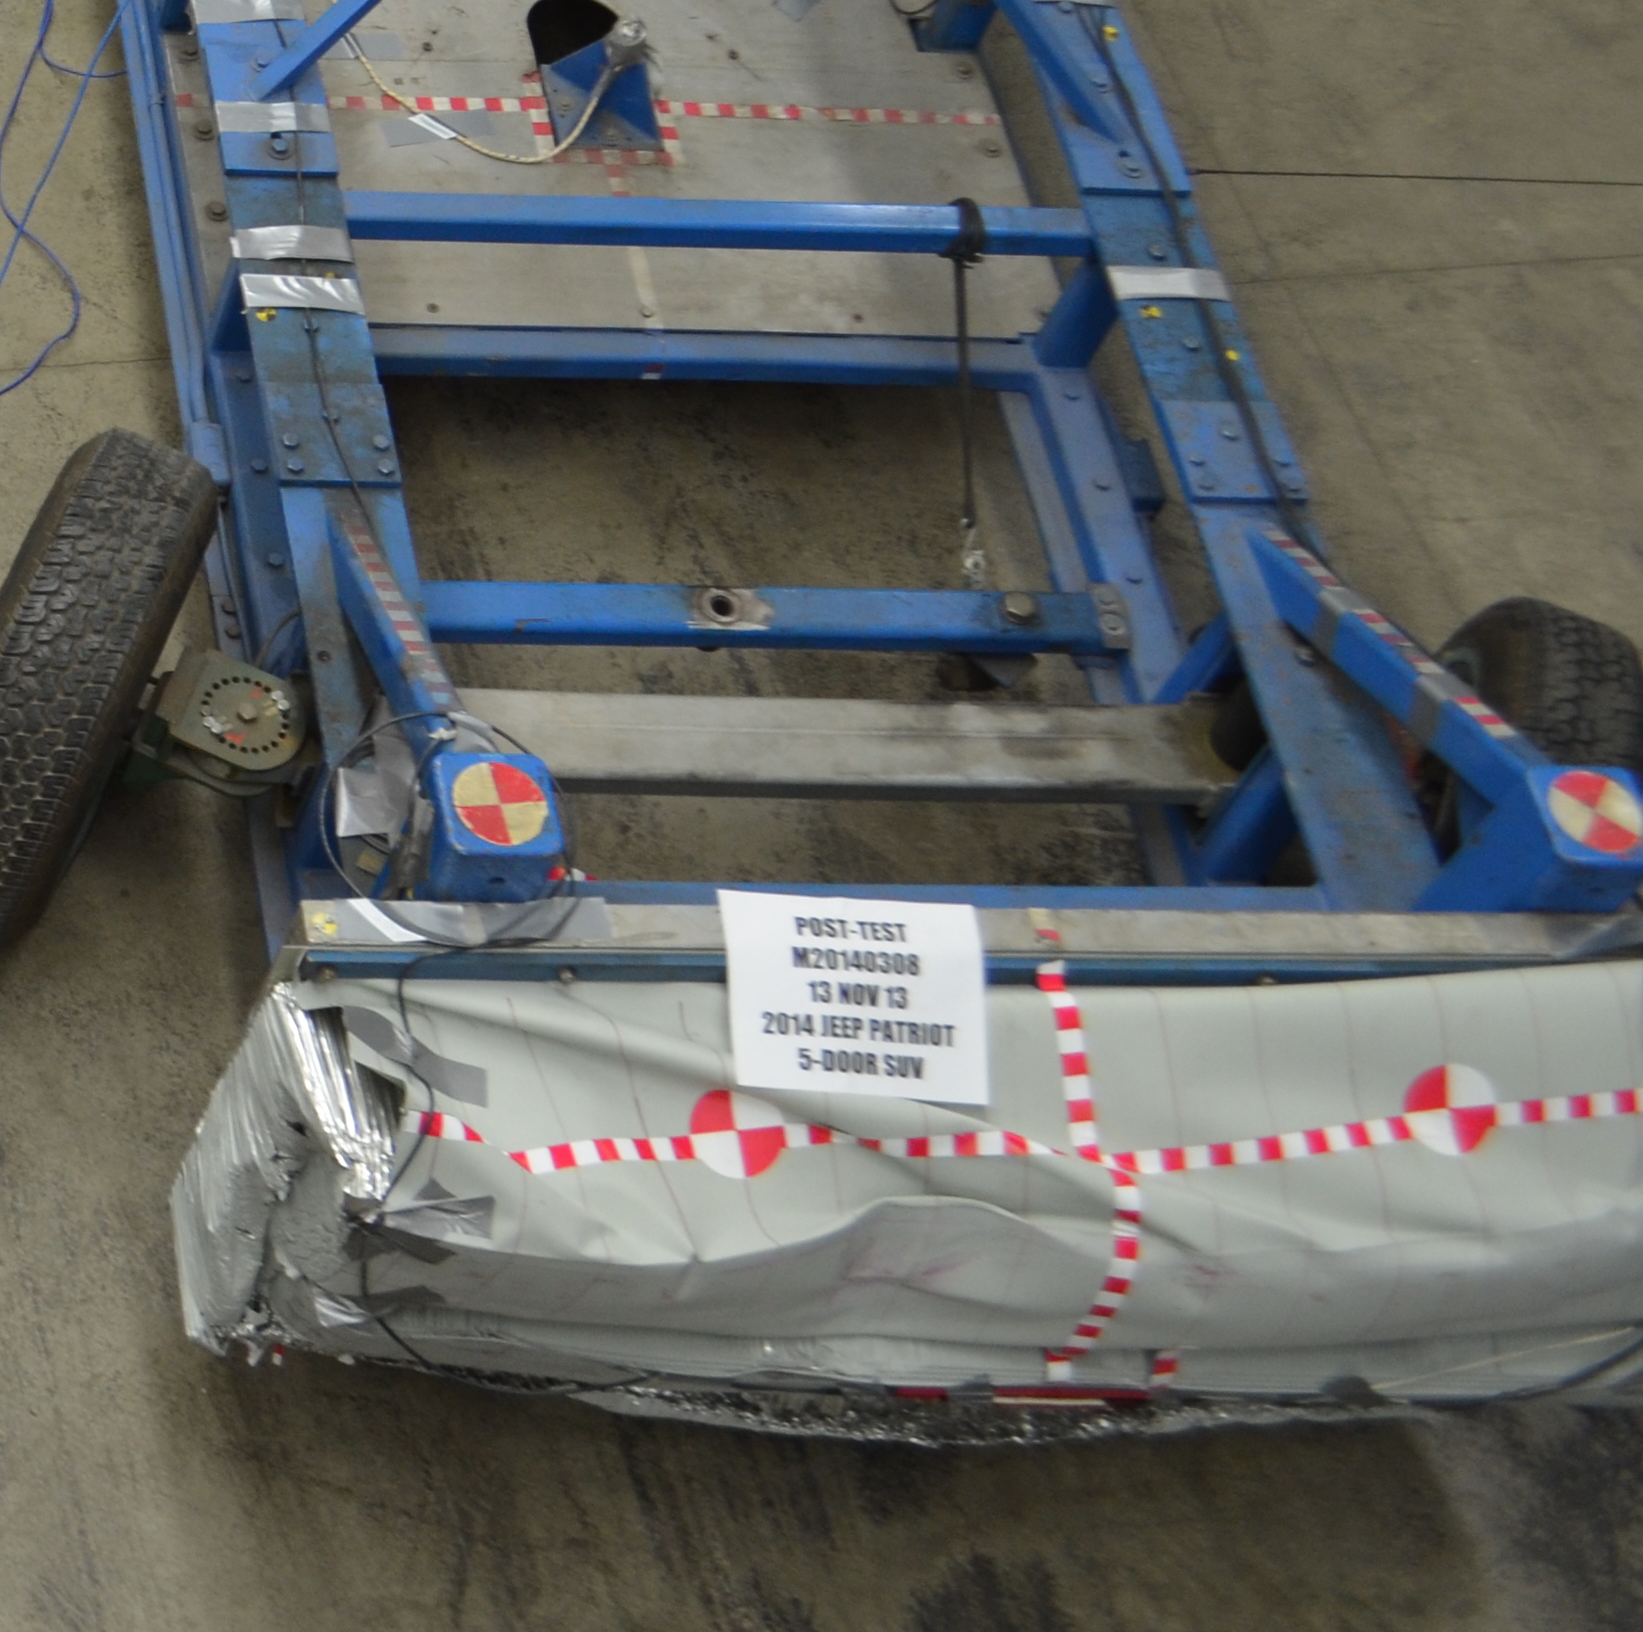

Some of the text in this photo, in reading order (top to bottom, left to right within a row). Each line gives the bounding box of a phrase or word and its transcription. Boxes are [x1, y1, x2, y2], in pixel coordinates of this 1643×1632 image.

[794, 917, 907, 943] POST-TEST
[792, 946, 920, 976] M20140308
[808, 981, 909, 1010] 13 NOV 13
[762, 1011, 957, 1048] 2014 JEEP PATRIOT
[798, 1048, 924, 1080] 5-DOOR SUV
